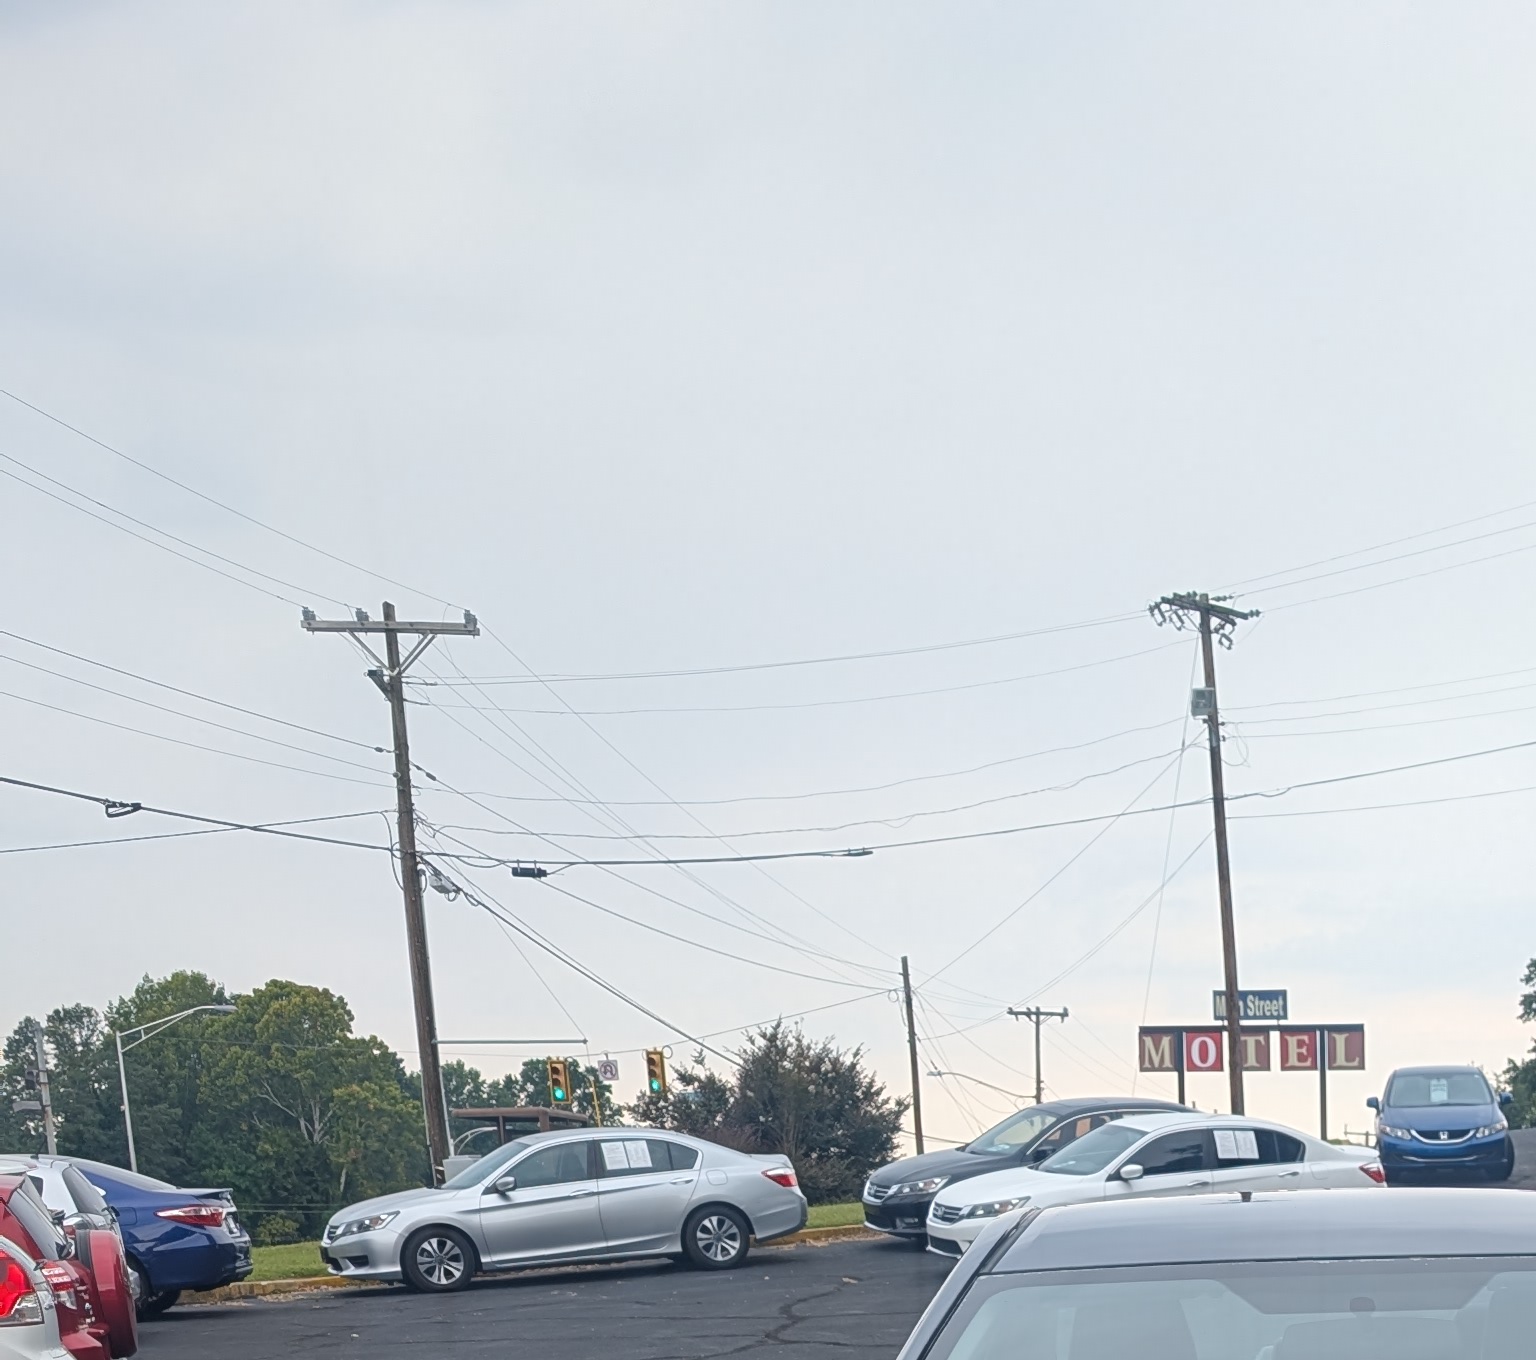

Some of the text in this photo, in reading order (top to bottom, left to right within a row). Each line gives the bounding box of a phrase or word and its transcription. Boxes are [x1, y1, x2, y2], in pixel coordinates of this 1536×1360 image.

[1216, 995, 1284, 1016] Mn Street
[1142, 1035, 1359, 1068] MOTEL
